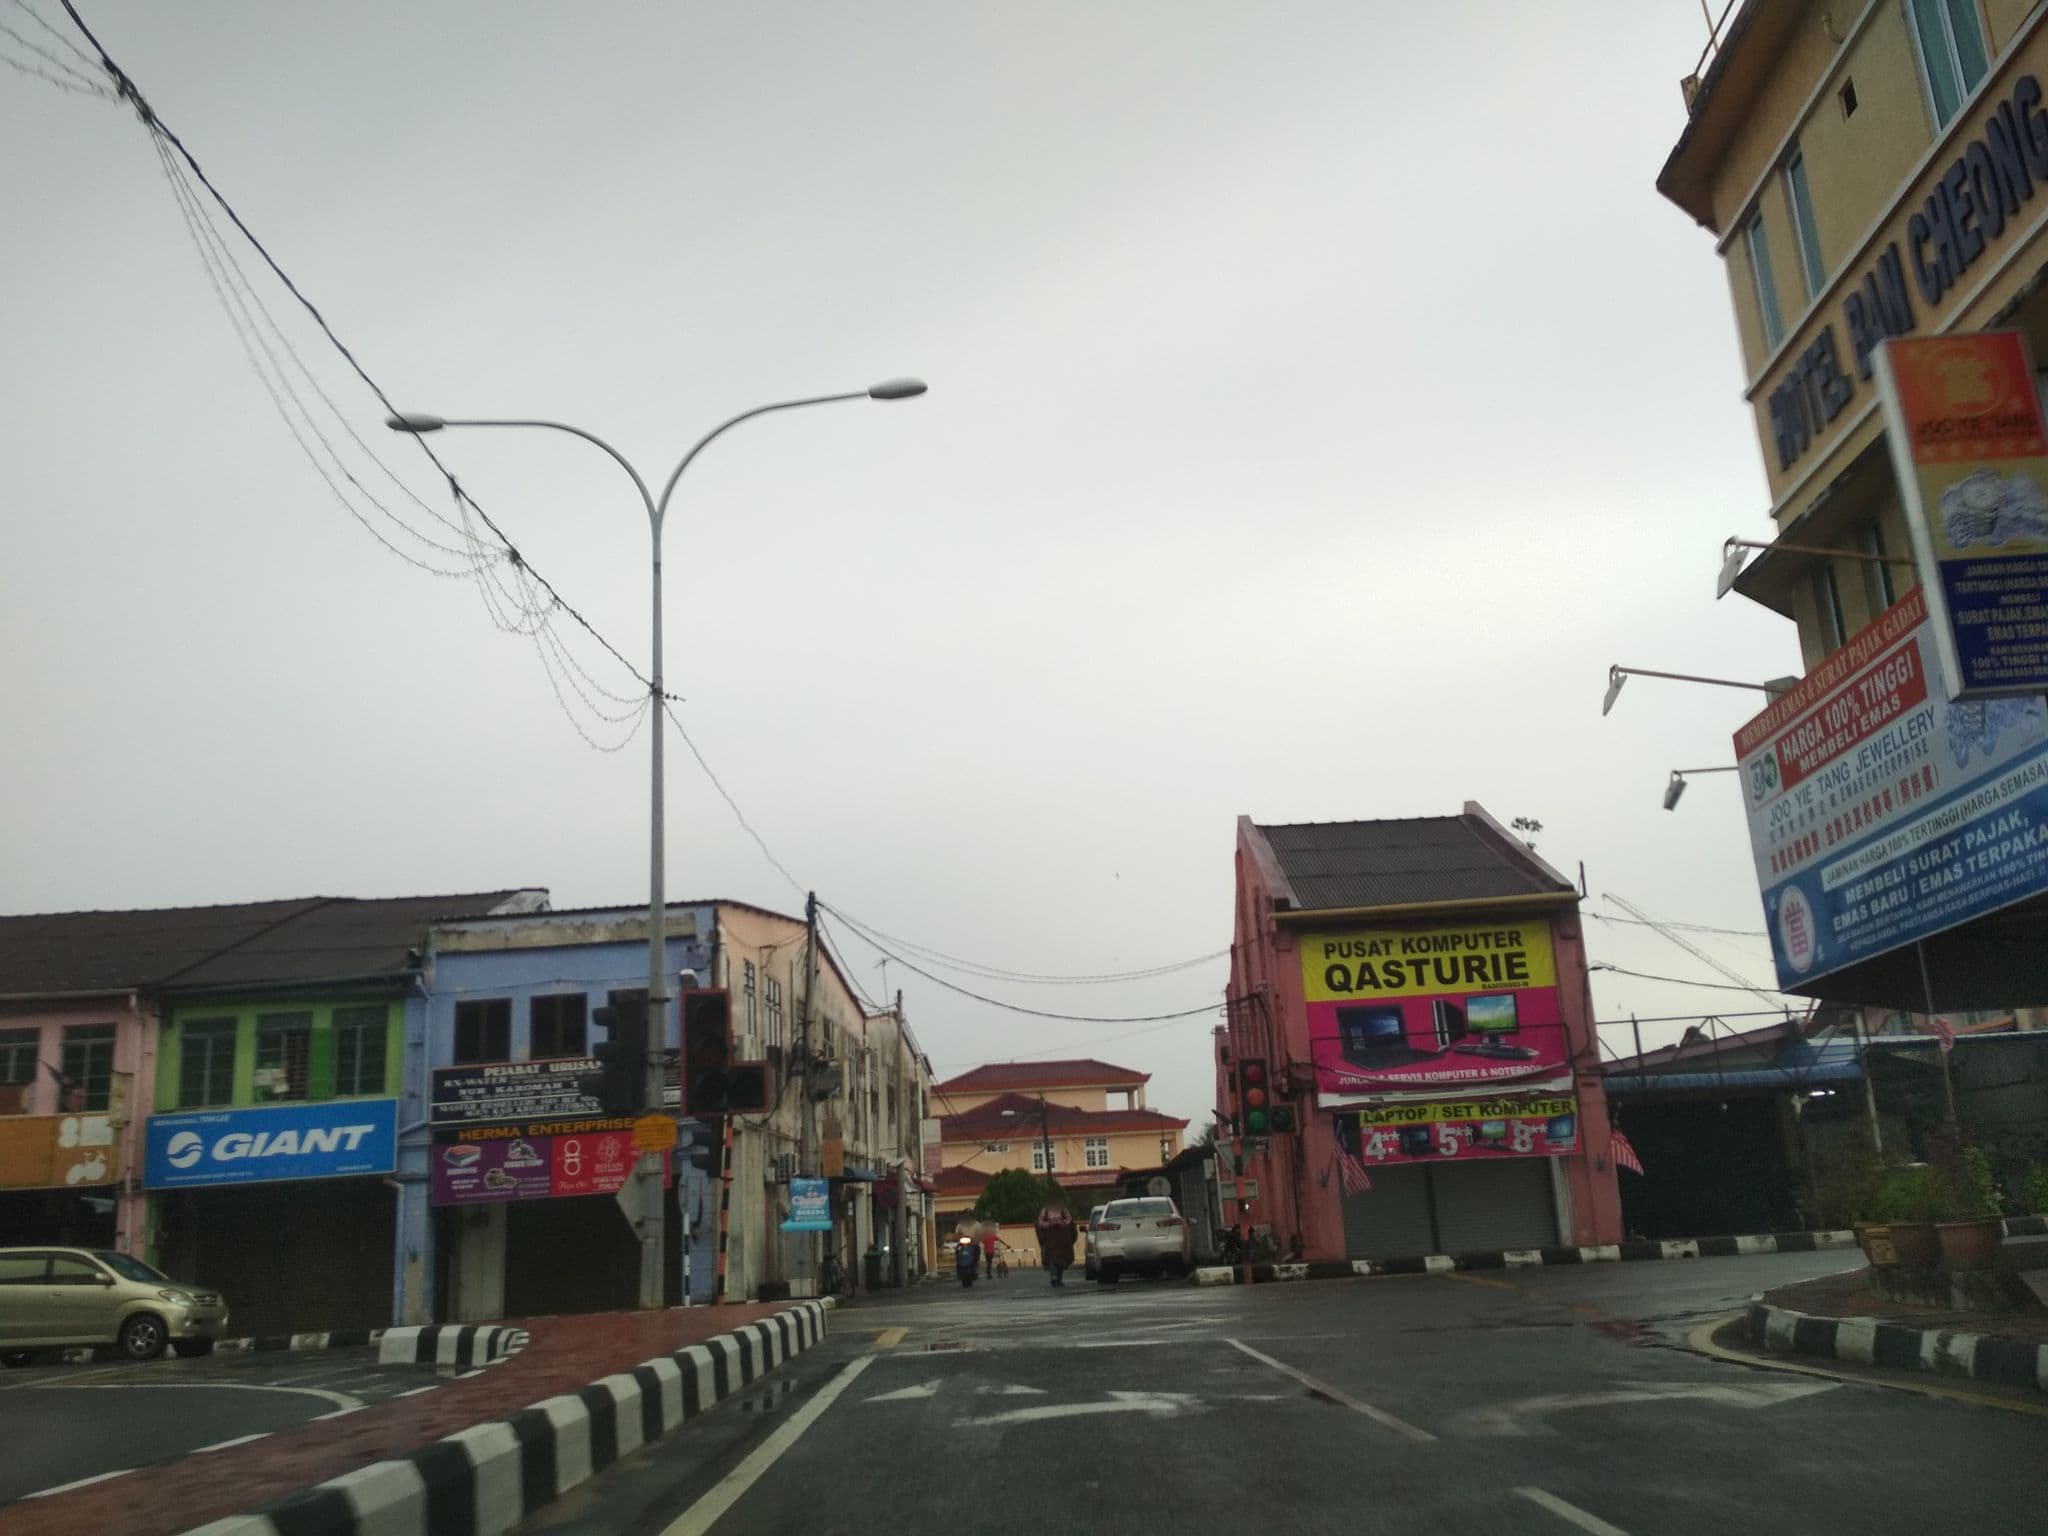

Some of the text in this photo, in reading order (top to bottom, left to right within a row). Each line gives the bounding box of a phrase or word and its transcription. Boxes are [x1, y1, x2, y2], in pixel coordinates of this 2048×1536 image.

[1780, 651, 1915, 764] HARGA 100% TINGGI
[1799, 693, 1902, 774] MEMBELI EMAS
[1769, 799, 1791, 827] JOO
[1794, 783, 1814, 809] YIE
[1816, 760, 1851, 795] TANG
[1856, 705, 1937, 773] JEWELLERY
[1845, 809, 2029, 905] MEMBELI SURAT PAJAK,
[1859, 844, 1888, 867] HARGA
[1833, 904, 1869, 931] EMAS
[1870, 885, 1908, 915] BARU
[1919, 862, 1963, 895] EMAS
[1324, 931, 1523, 959] PUSAT KOMPUTER
[1325, 952, 1530, 993] QASTURIE
[483, 1063, 541, 1077] PEJABAT
[1424, 1068, 1478, 1080] KOMPUTER
[1480, 1068, 1489, 1077] &
[459, 1126, 522, 1141] HERMA
[527, 1117, 634, 1136] ENTERPRISE
[1363, 1108, 1428, 1123] LAPTOP
[1441, 1105, 1474, 1118] SET
[1480, 1101, 1576, 1116] KOMPUTER
[211, 1124, 376, 1161] GIANT
